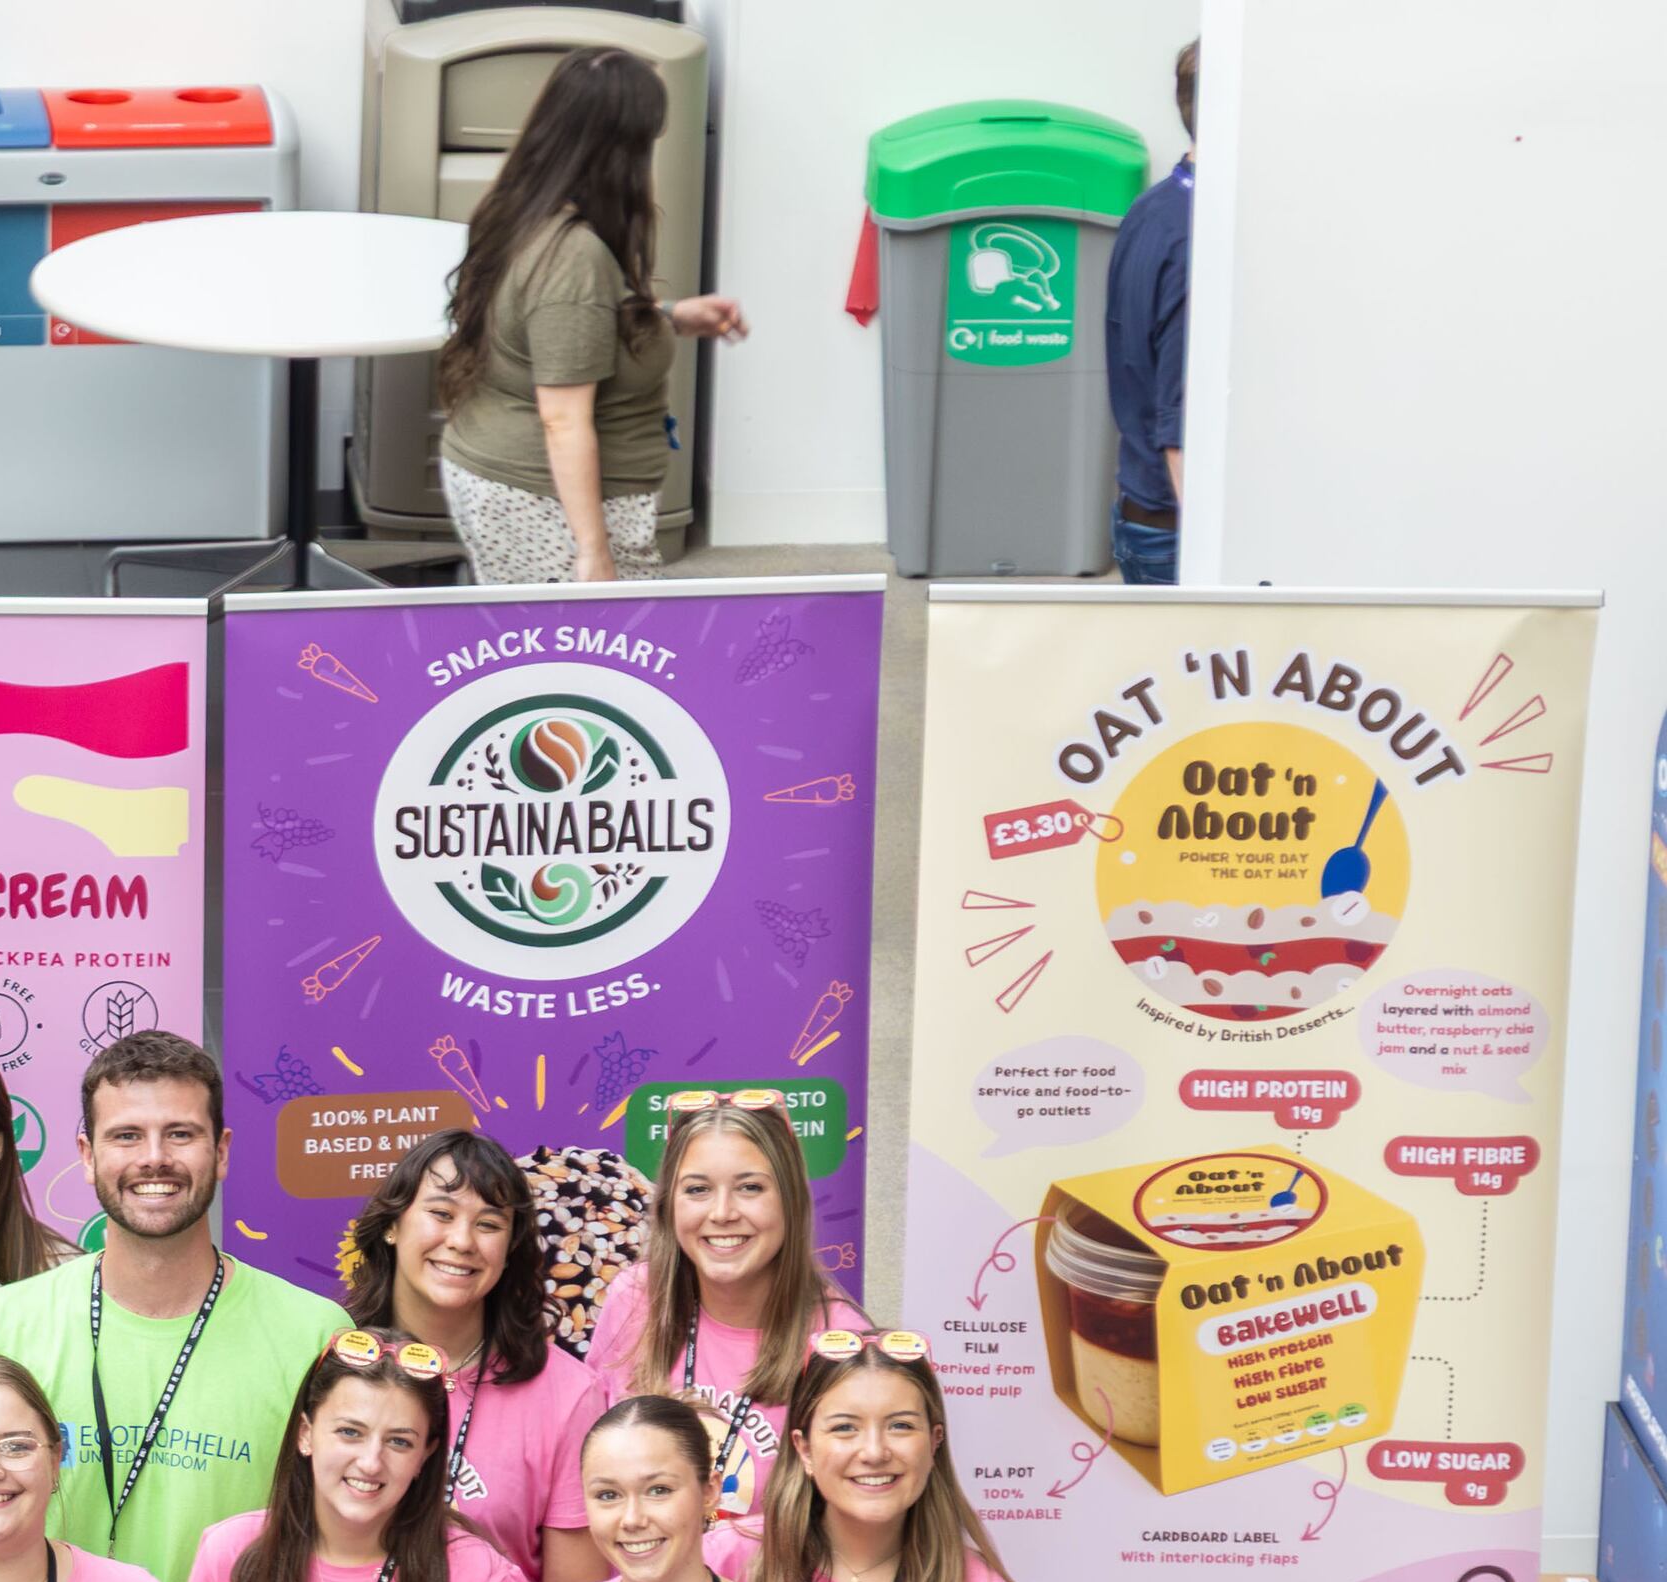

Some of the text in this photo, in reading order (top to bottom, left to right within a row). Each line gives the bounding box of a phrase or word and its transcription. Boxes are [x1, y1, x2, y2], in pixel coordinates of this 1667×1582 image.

[989, 330, 1069, 345] food waste
[426, 626, 677, 687] SNACK SMART.
[1056, 677, 1164, 785] OAT
[1272, 651, 1467, 787] ABOUT
[394, 799, 715, 860] SUSTAINABALLS
[991, 813, 1074, 847] £3.30
[1179, 852, 1309, 865] POWER YOUR DAY
[1210, 867, 1308, 879] THE OAT WAY
[75, 952, 171, 968] PROTEIN
[2, 977, 35, 1004] FREE
[440, 972, 661, 1018] WASTE LESS.
[1135, 997, 1195, 1034] Inspired
[1197, 1026, 1217, 1043] by
[1220, 1028, 1273, 1043] British
[1192, 1078, 1347, 1099] HIGH PROTEIN
[310, 1106, 440, 1127] 100% PLANT
[1291, 1105, 1322, 1124] 19g
[304, 1135, 392, 1154] BASED &
[1401, 1145, 1526, 1165] HIGH FIBRE
[1383, 1450, 1431, 1469] LOW
[1437, 1451, 1511, 1471] SUGAR
[1142, 1530, 1280, 1544] CARDBOARD LABEL
